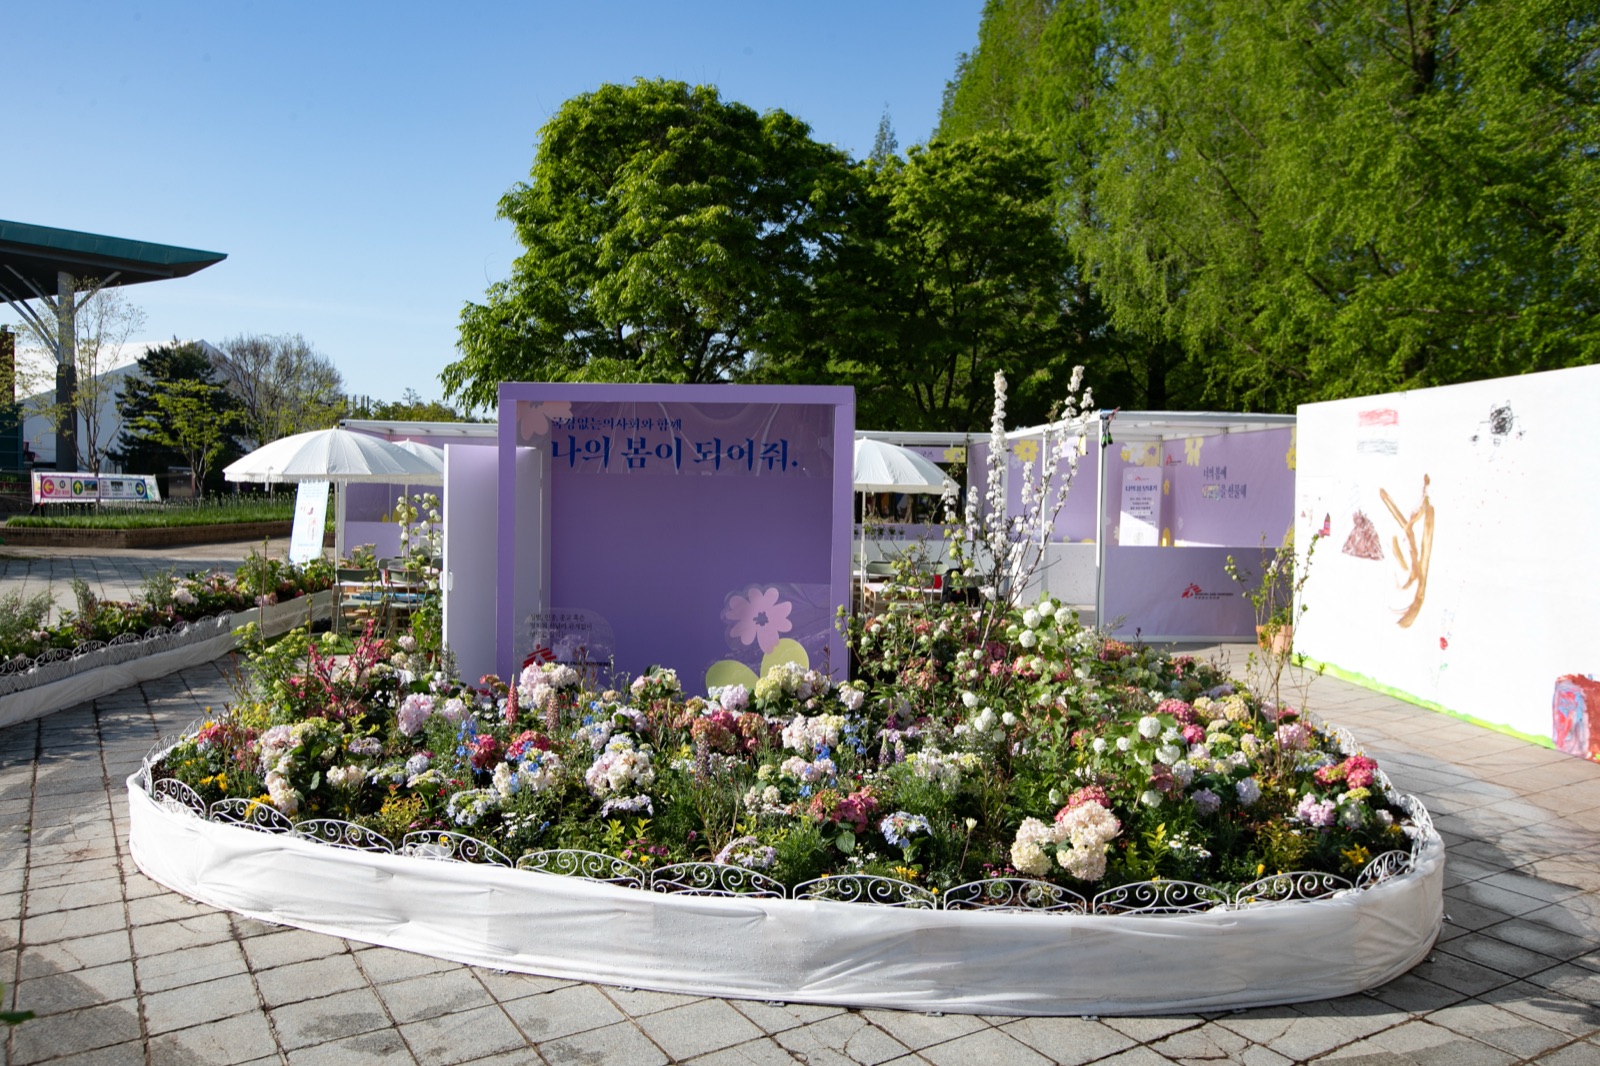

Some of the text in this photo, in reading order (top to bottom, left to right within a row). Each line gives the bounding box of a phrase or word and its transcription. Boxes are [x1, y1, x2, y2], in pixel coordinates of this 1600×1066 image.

[657, 416, 682, 431] 함께
[551, 434, 798, 472] 나의 봄이 되어줘.
